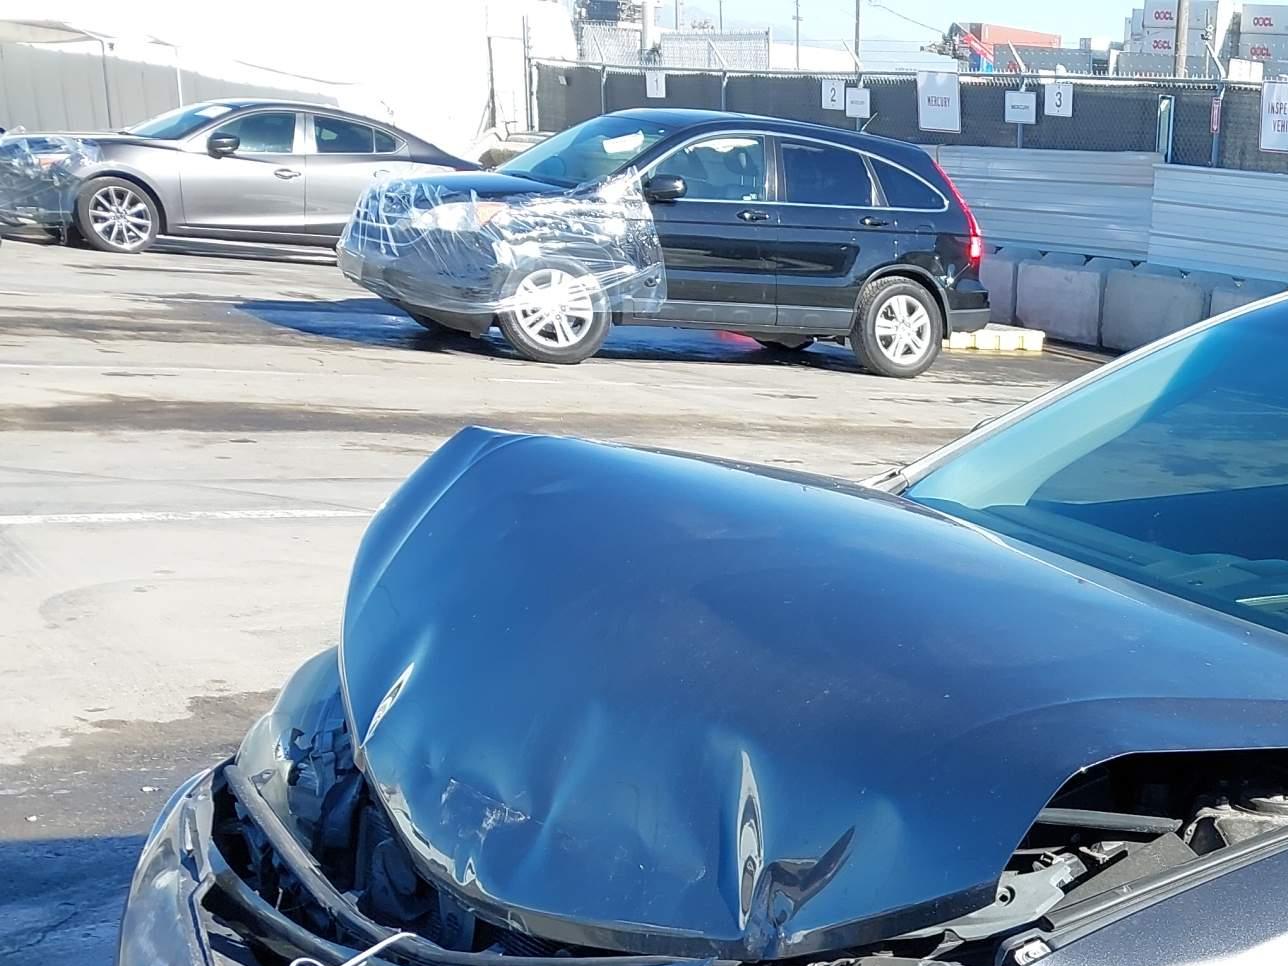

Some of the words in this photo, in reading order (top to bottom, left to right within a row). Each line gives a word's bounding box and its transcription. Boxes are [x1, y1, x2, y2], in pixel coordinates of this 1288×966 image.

[830, 87, 837, 102] 2
[926, 95, 951, 108] MERCURY
[1055, 91, 1063, 108] 3
